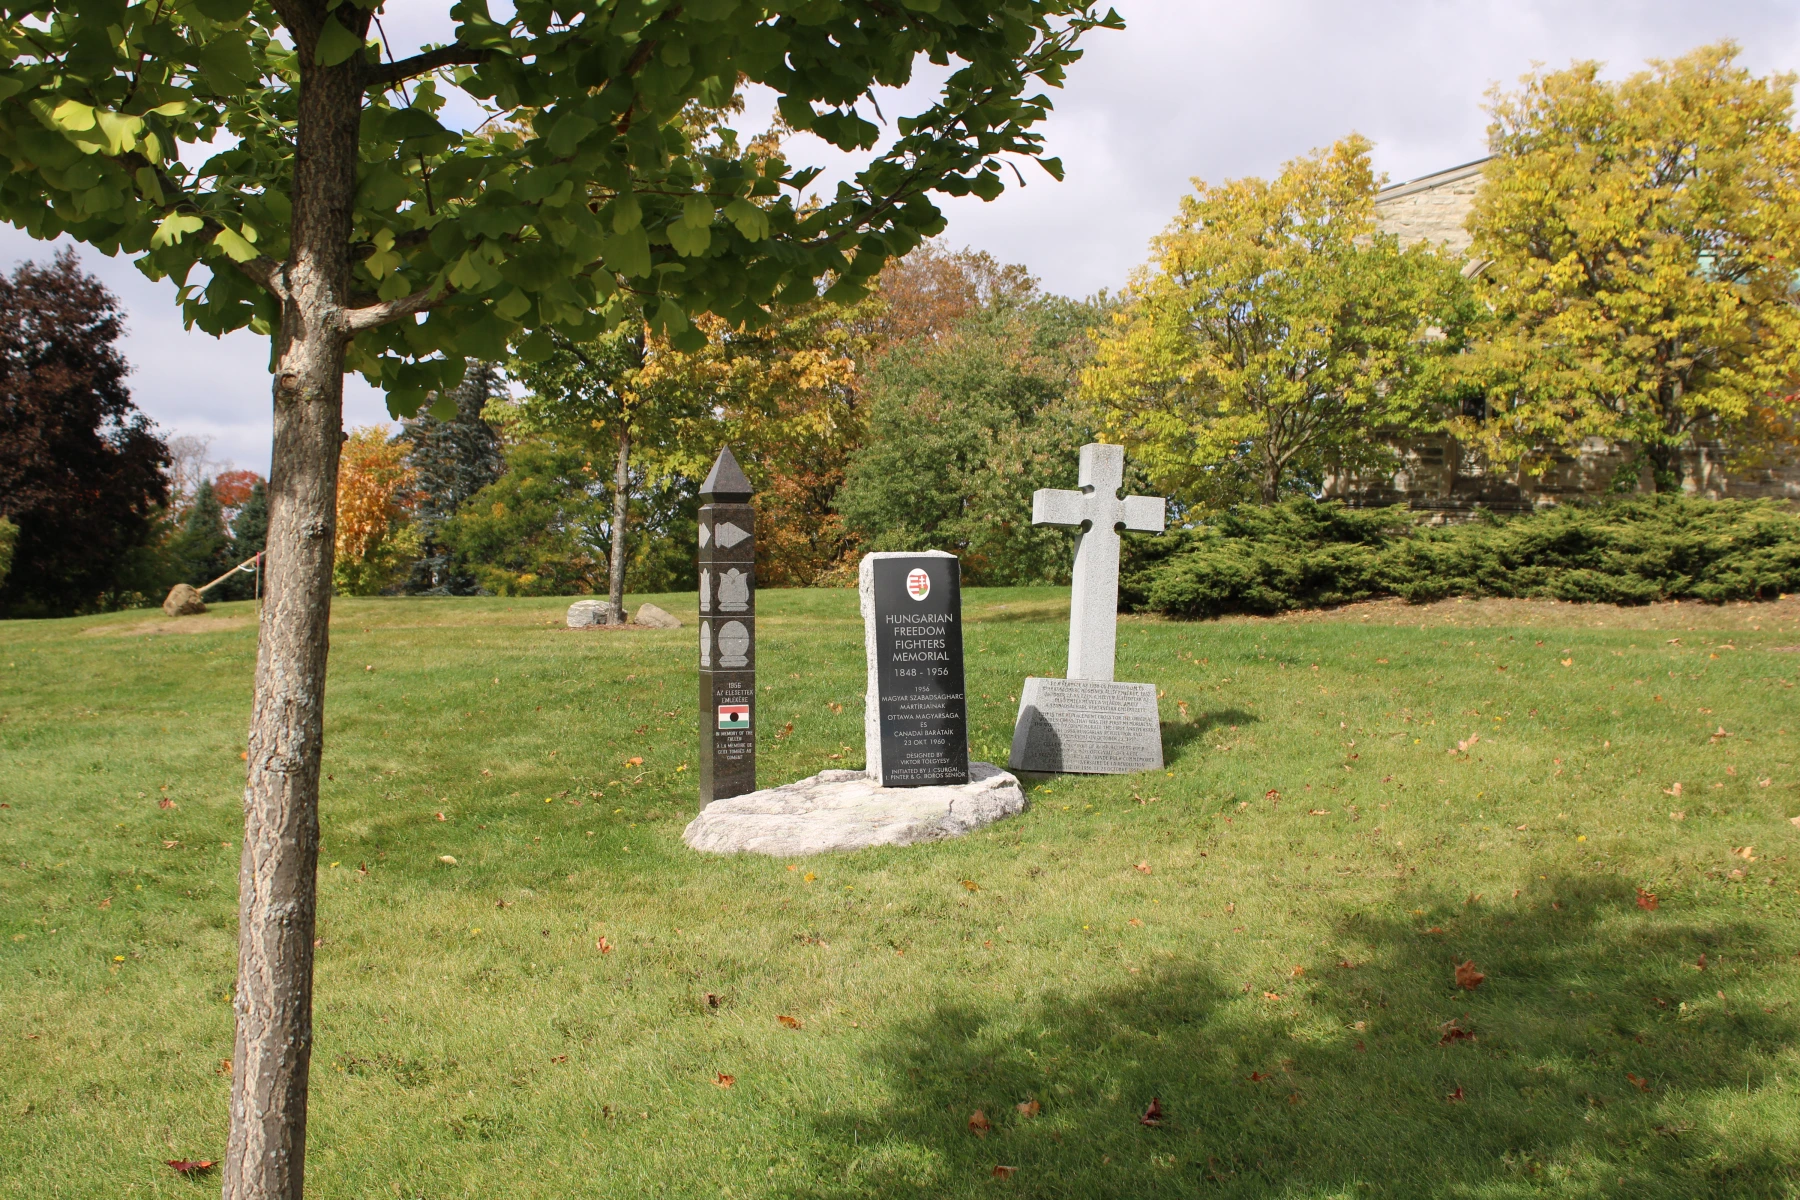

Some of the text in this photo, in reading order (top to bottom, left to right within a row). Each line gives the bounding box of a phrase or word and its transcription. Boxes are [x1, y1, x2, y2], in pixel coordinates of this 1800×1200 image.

[886, 614, 953, 623] HUNGARIAN
[894, 626, 945, 636] FREEDOM
[896, 639, 945, 649] FIGHTERS
[892, 652, 949, 661] MEMORIAL
[895, 668, 917, 676] 1848
[927, 668, 948, 676] 1956
